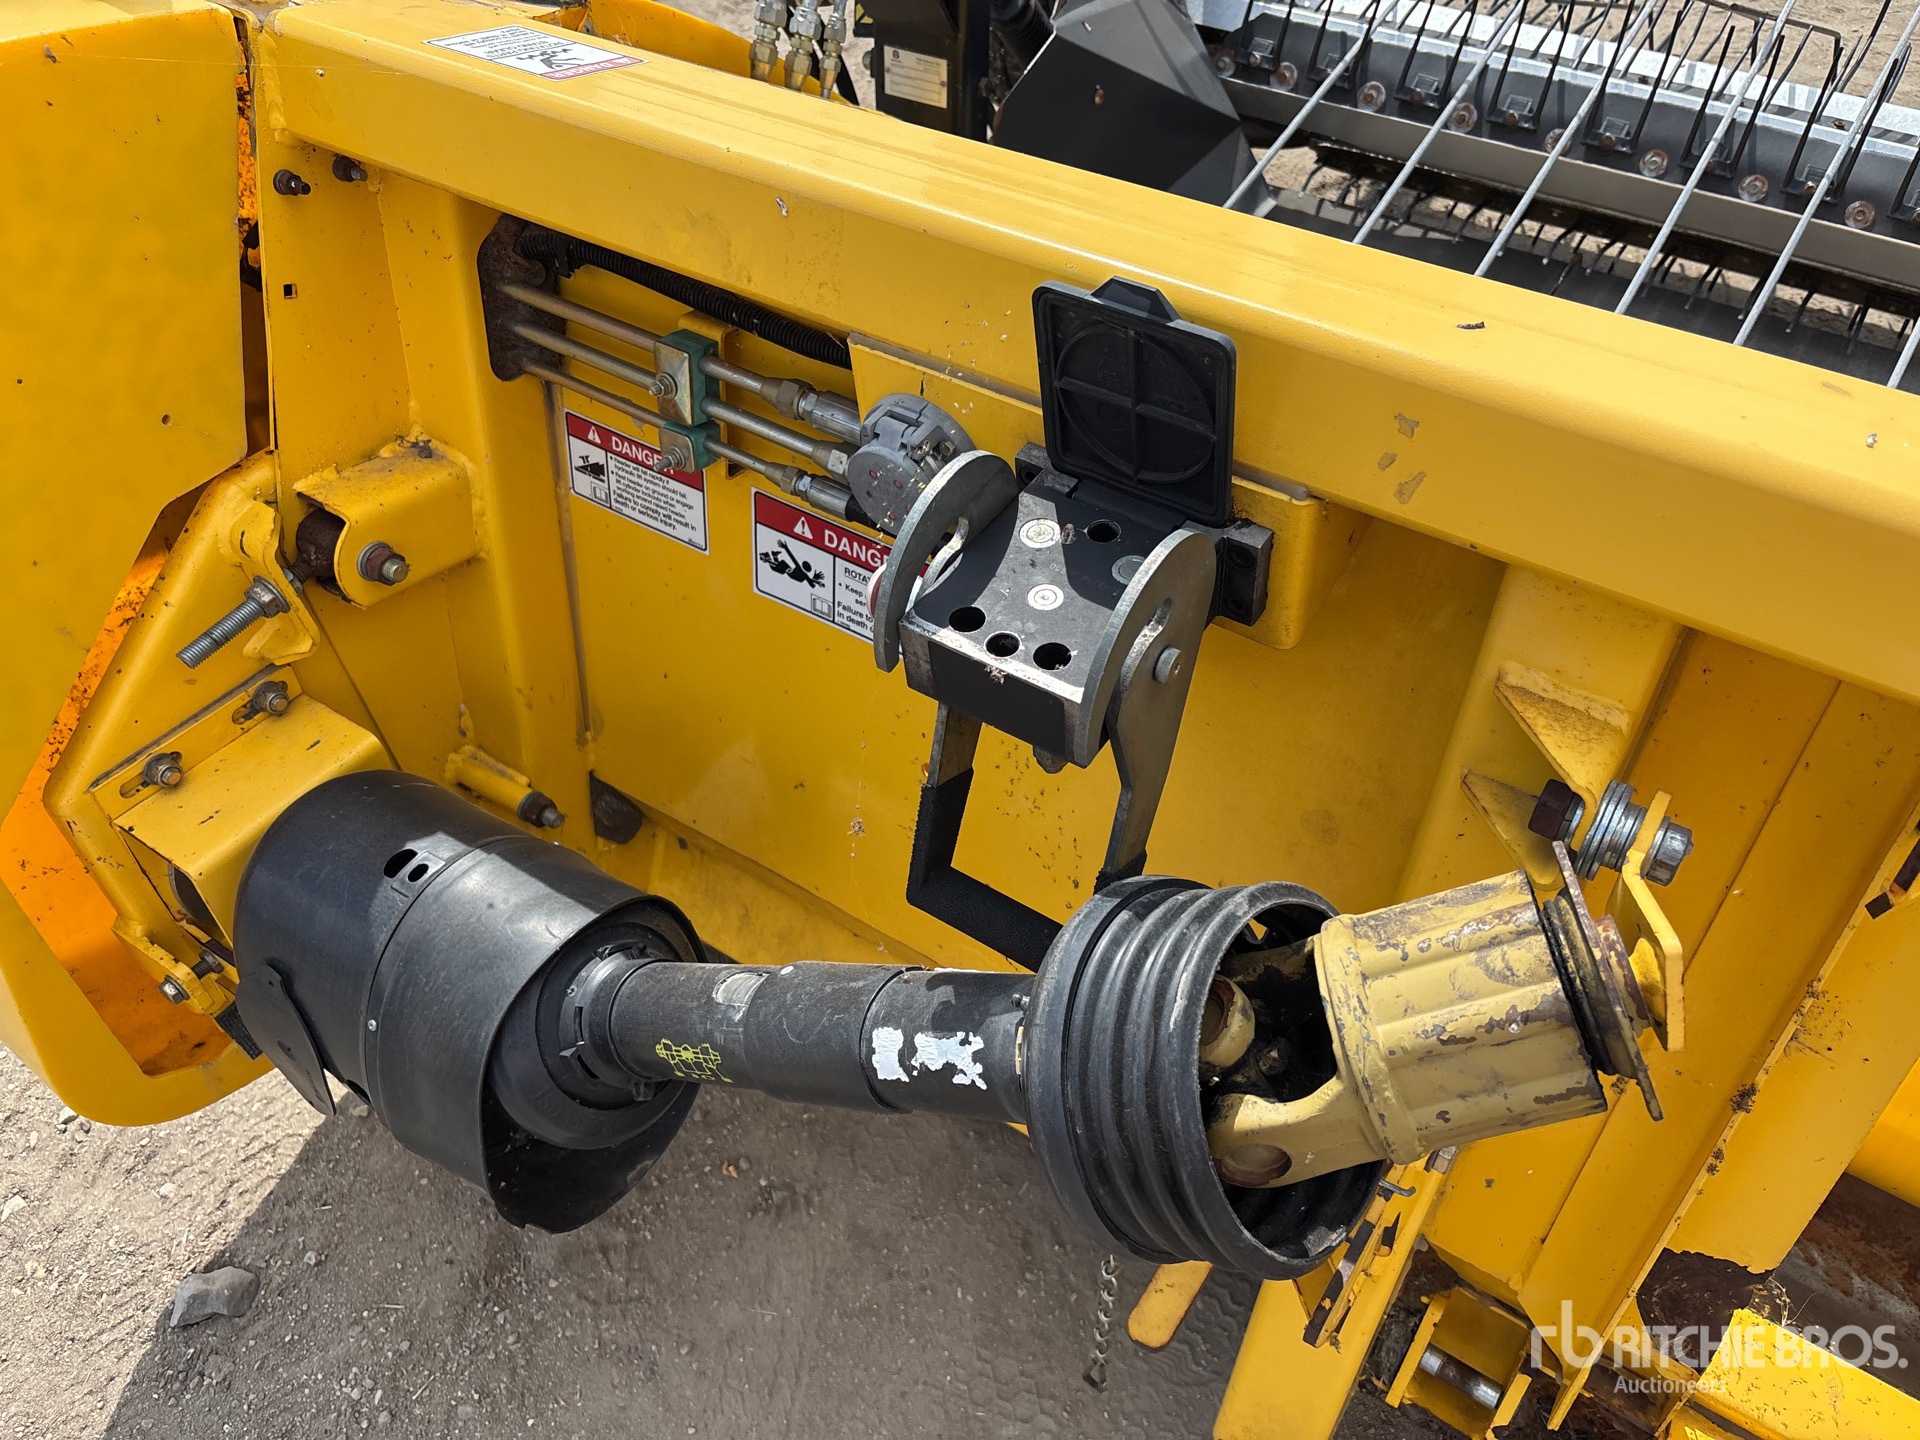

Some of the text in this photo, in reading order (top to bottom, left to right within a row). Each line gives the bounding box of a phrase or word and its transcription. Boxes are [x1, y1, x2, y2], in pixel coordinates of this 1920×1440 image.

[550, 62, 613, 77] DANGER
[612, 435, 674, 475] DANGE
[652, 488, 668, 499] ground
[613, 490, 697, 532] Failure to comply will result in
[614, 498, 630, 509] death
[638, 508, 659, 522] serious
[846, 583, 863, 597] Keep
[837, 601, 874, 623] Failure to
[846, 616, 868, 630] death
